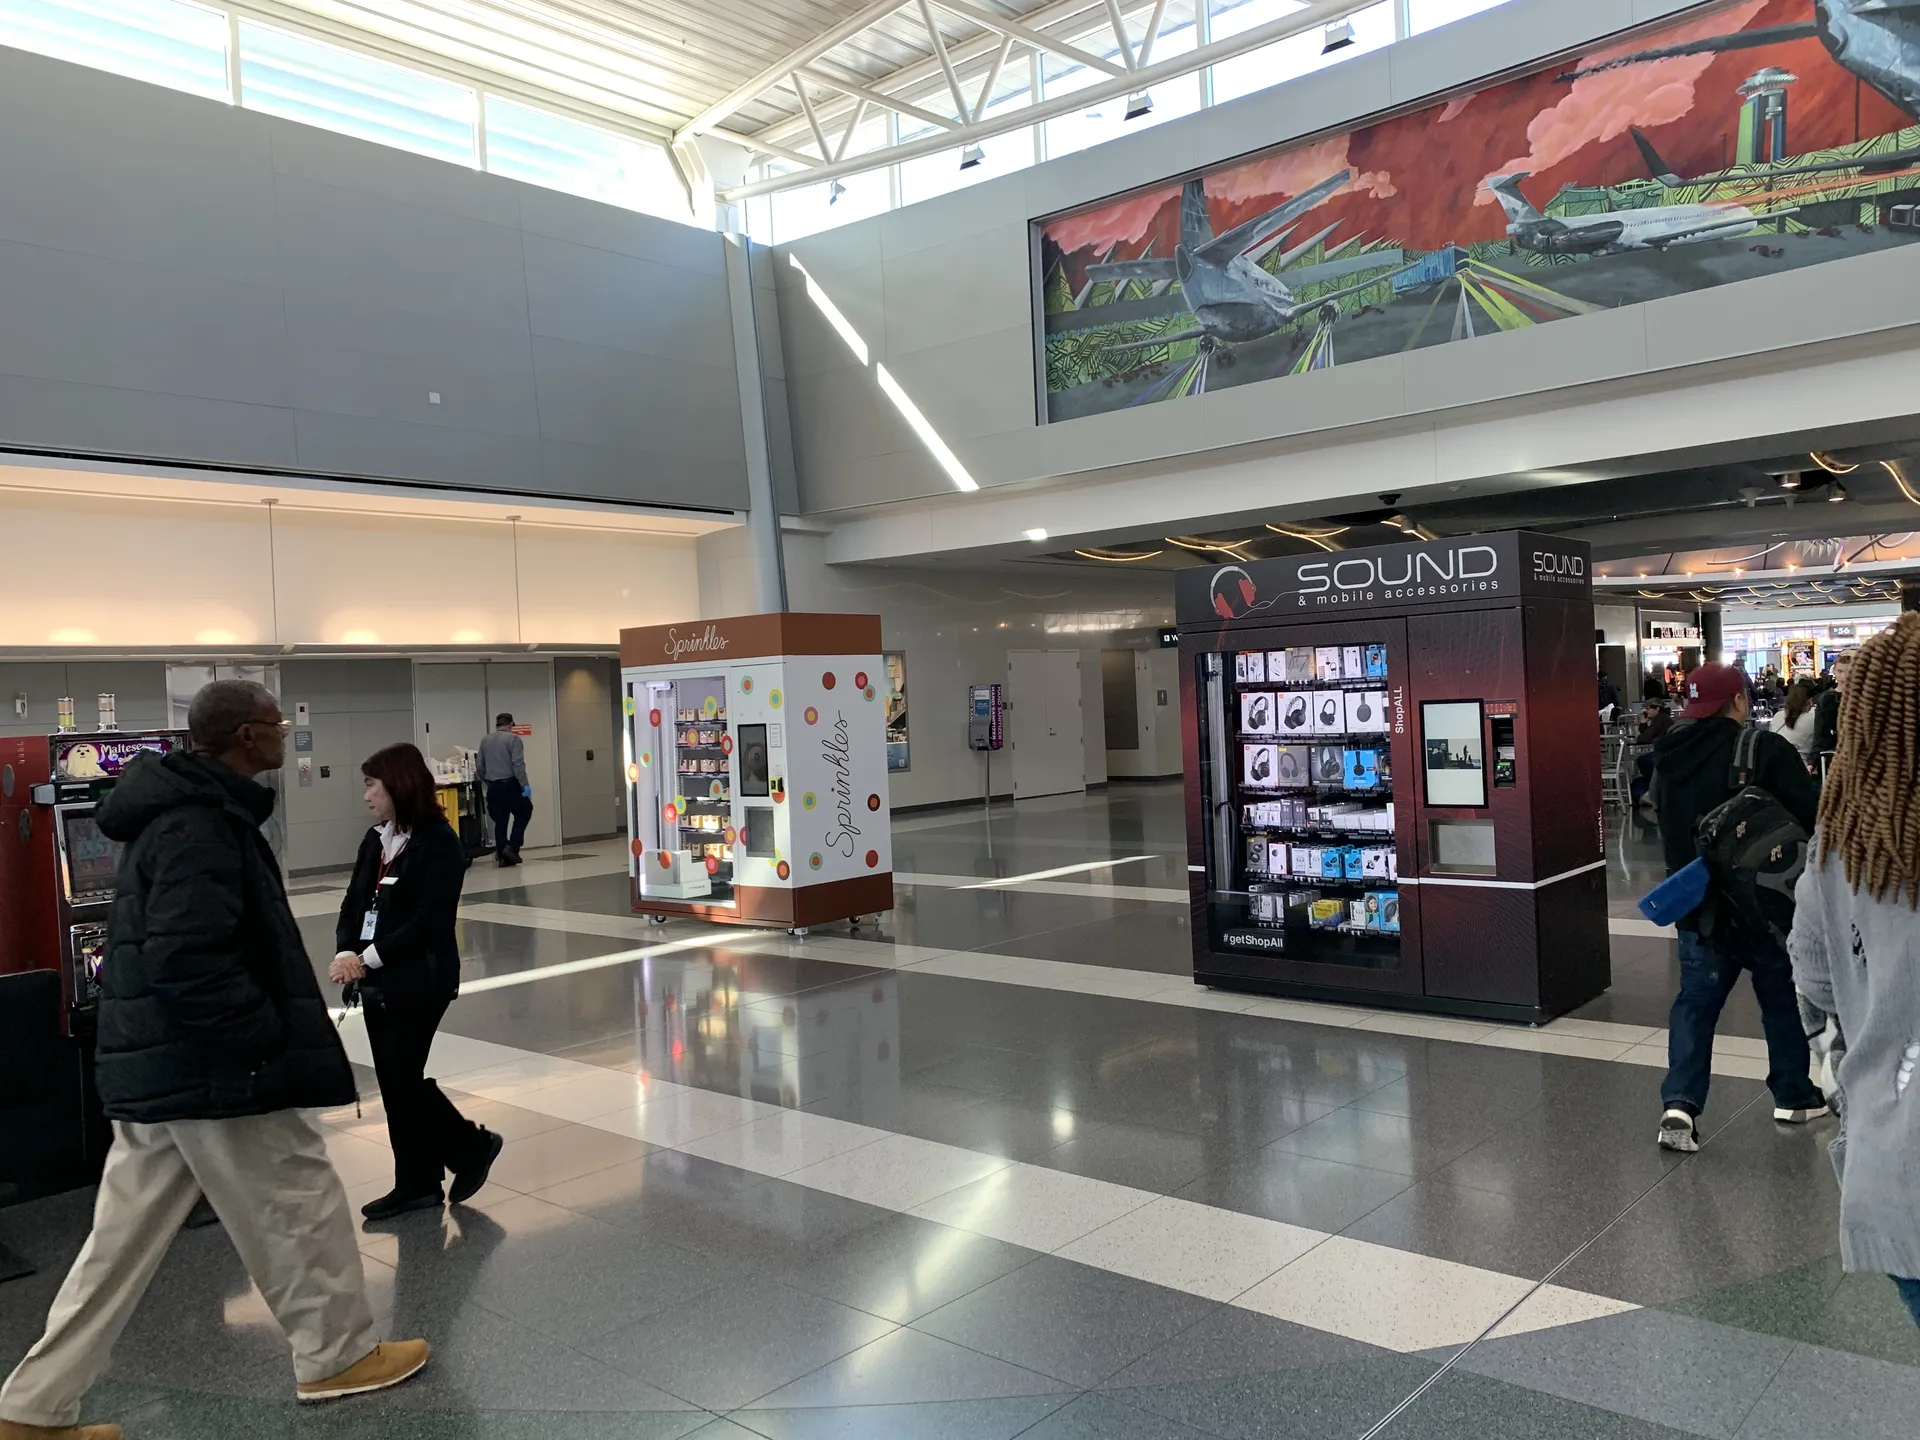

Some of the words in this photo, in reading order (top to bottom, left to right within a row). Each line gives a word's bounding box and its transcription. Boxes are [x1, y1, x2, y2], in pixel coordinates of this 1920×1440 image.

[1297, 546, 1497, 594] SOUND
[1532, 551, 1584, 576] SOUND
[1298, 595, 1306, 606] &
[1317, 589, 1374, 604] mobile
[1384, 579, 1499, 599] accessories
[1539, 574, 1556, 582] mobile
[1557, 576, 1585, 584] accessories
[664, 624, 730, 661] Sprinkles
[1393, 685, 1405, 734] ShopALL
[97, 742, 143, 763] Maltese
[821, 709, 861, 858] Sprinkles
[1223, 933, 1283, 948] #getShopAll
